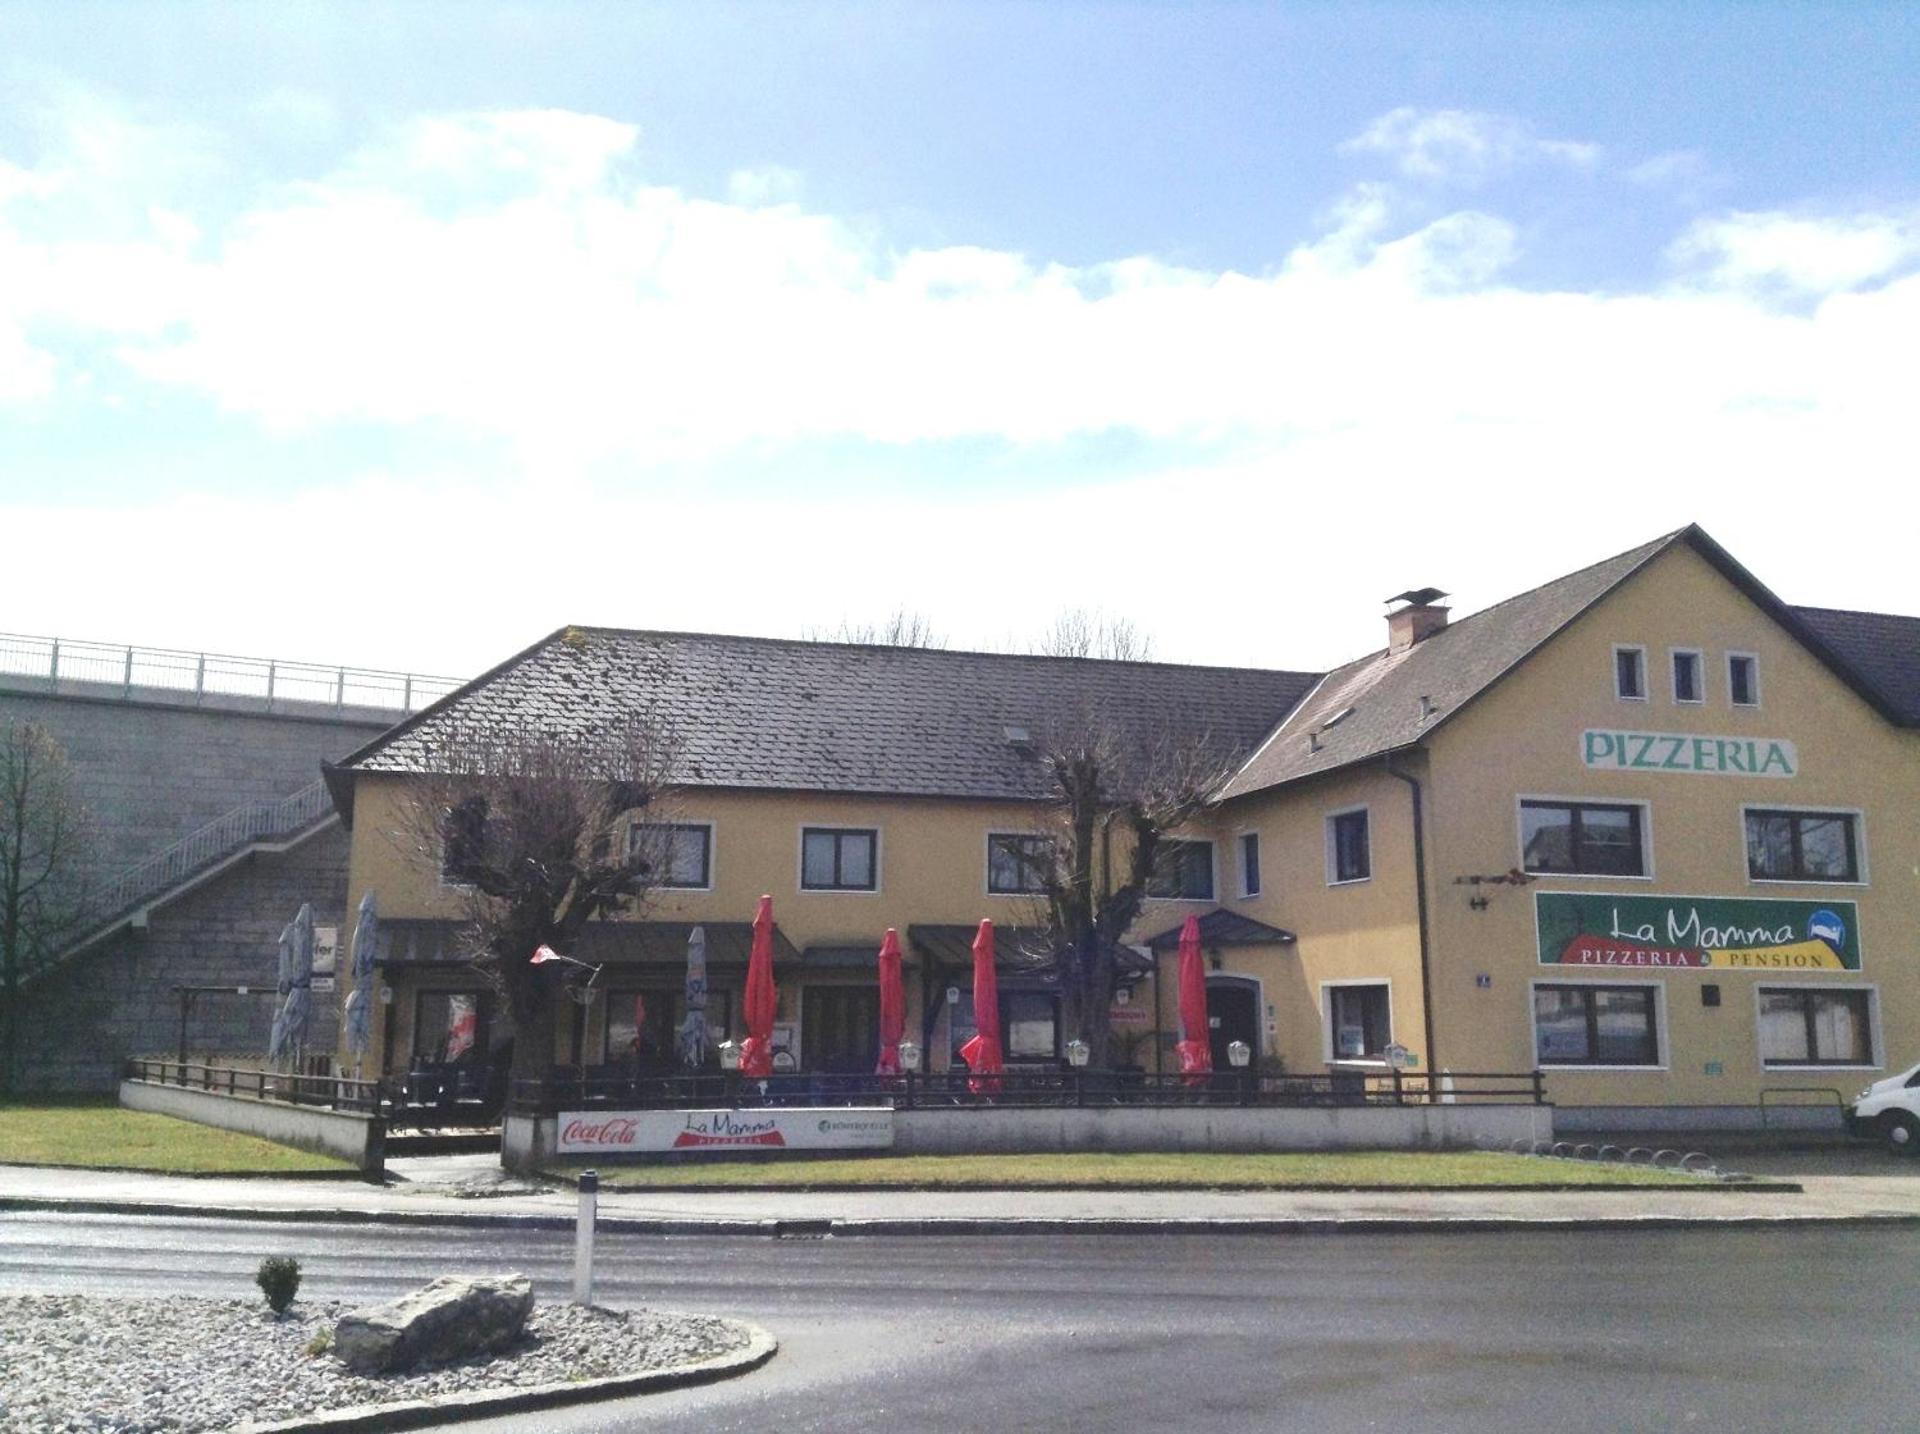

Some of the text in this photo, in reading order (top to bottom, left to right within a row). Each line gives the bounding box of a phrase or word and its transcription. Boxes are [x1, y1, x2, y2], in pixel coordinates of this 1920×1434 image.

[1584, 732, 1793, 774] PIZZERIA
[1610, 907, 1795, 948] La Mamma
[1581, 949, 1688, 966] PIZZERIA
[1729, 953, 1822, 967] PENSION
[562, 1118, 640, 1145] Coca-Cola
[686, 1112, 776, 1137] La Mamma
